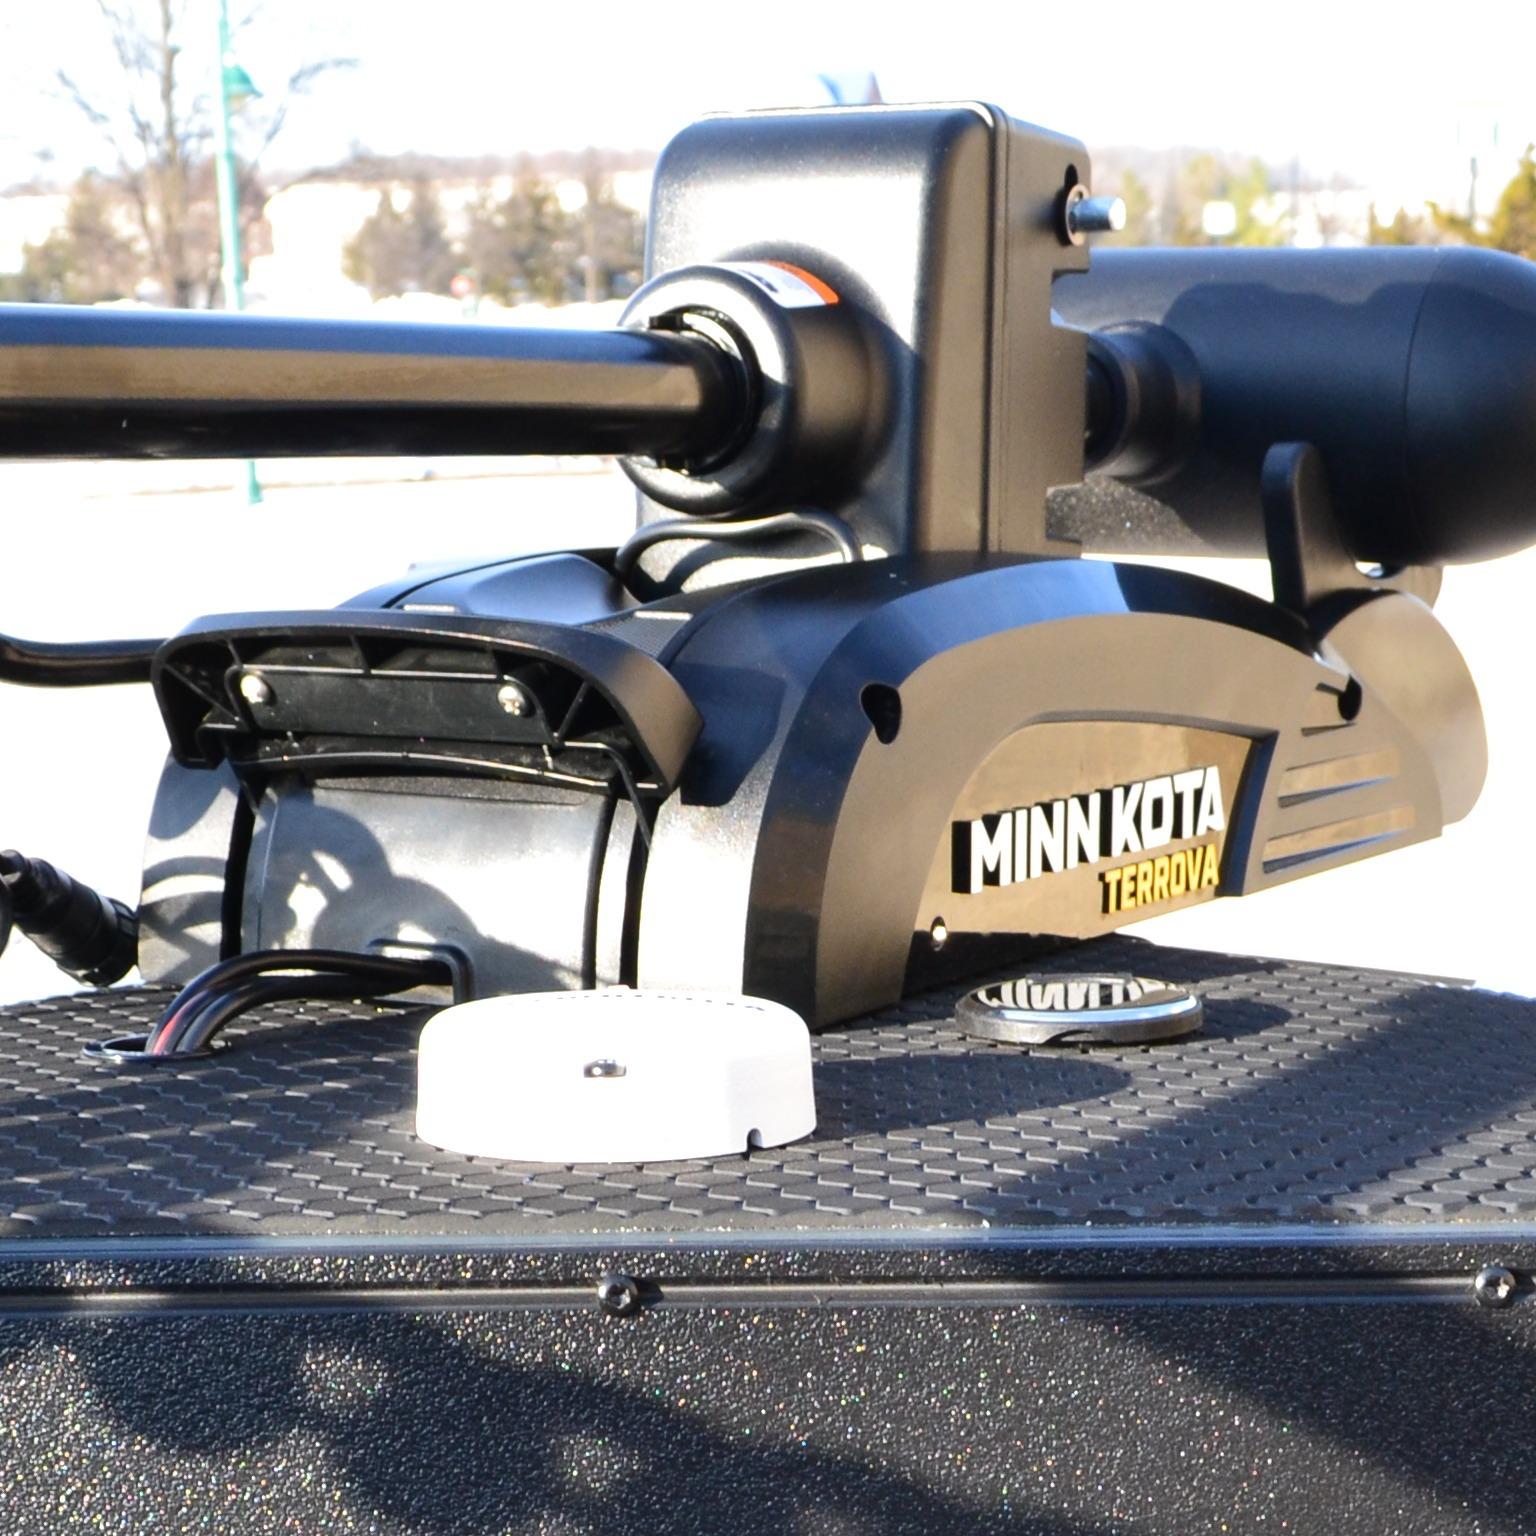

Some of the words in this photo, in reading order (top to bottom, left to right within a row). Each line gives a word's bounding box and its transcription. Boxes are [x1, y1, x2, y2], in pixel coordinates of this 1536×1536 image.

[967, 790, 1102, 895] MINN
[1111, 765, 1225, 858] KOTA
[1103, 843, 1219, 914] TERROVA
